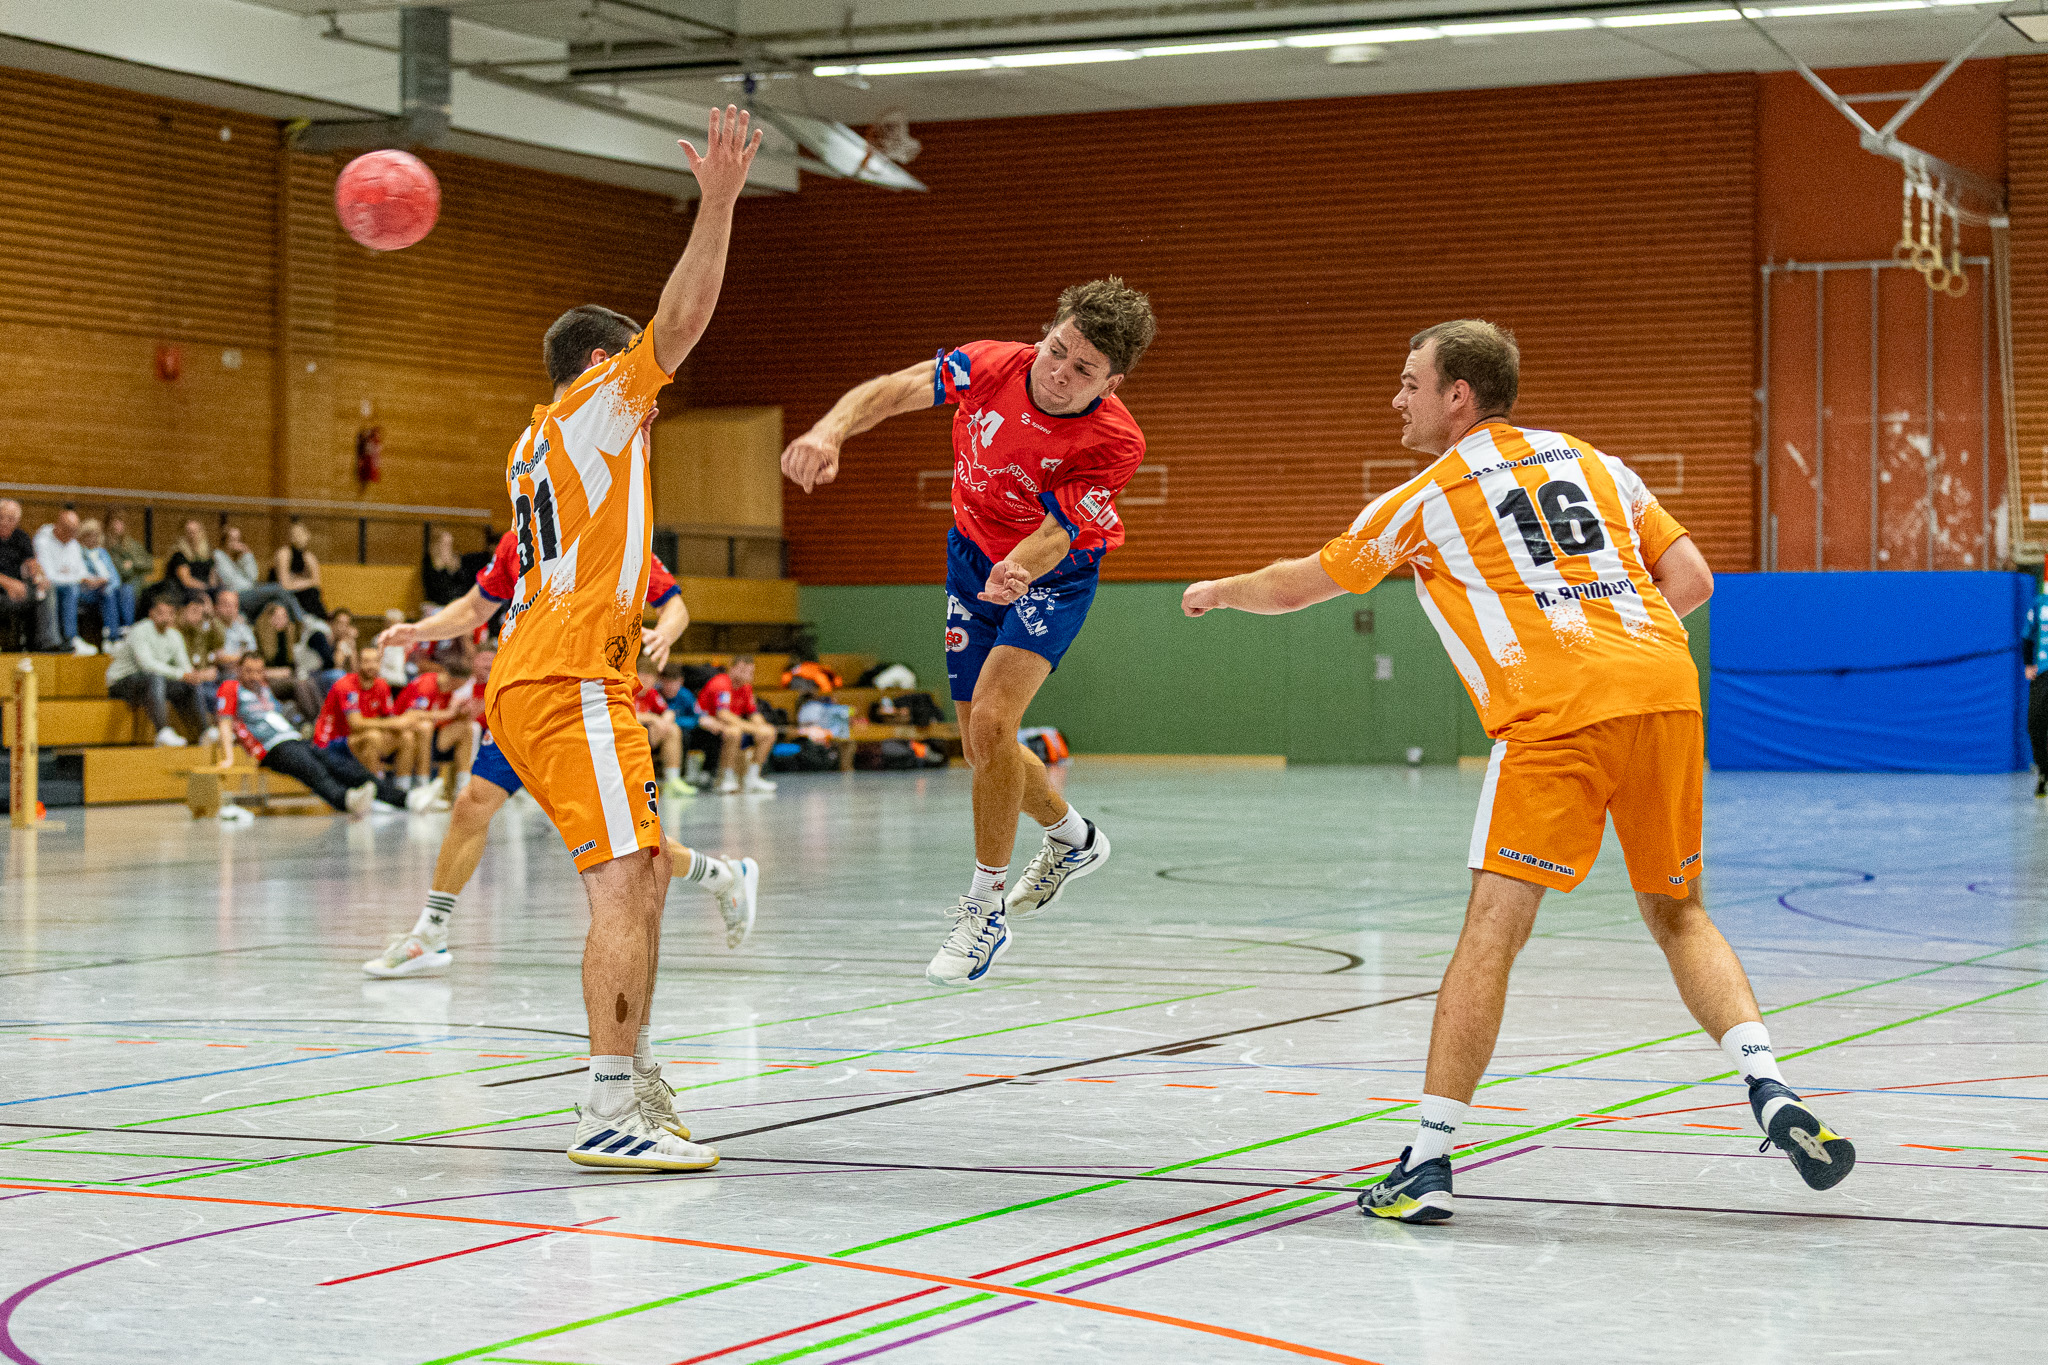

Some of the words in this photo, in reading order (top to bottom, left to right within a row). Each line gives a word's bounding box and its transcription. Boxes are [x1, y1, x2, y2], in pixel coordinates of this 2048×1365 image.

[515, 477, 558, 578] 31
[1496, 480, 1605, 567] 16
[1533, 591, 1557, 609] N.
[1498, 847, 1521, 861] ALLES
[1521, 854, 1538, 866] FÜR
[1538, 859, 1554, 871] DEN
[594, 1072, 632, 1083] Stauder
[1420, 1115, 1456, 1134] tauder
